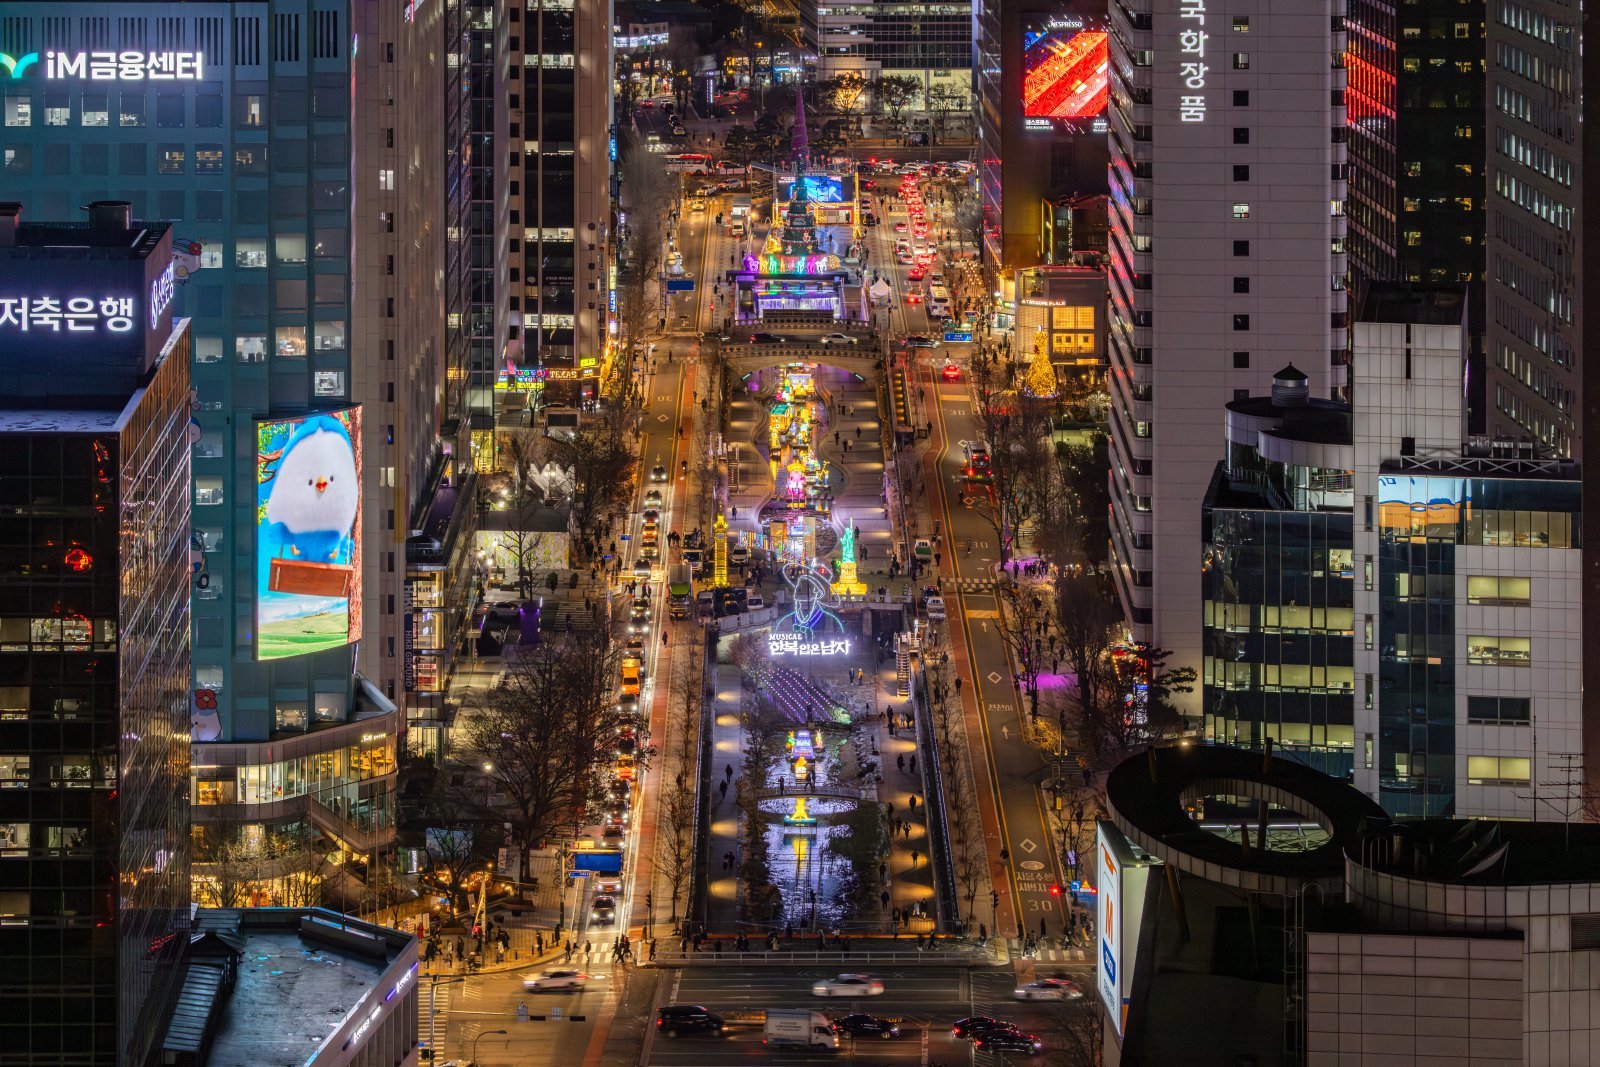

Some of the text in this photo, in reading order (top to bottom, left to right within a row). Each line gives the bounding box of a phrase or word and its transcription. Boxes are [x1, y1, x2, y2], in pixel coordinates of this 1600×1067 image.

[1050, 20, 1083, 28] NESPRESSO
[46, 51, 203, 80] iM금융센터
[0, 296, 134, 332] 저축은행
[549, 371, 578, 379] TEXAS
[769, 633, 803, 641] MUSICAL
[1027, 899, 1053, 912] 30
